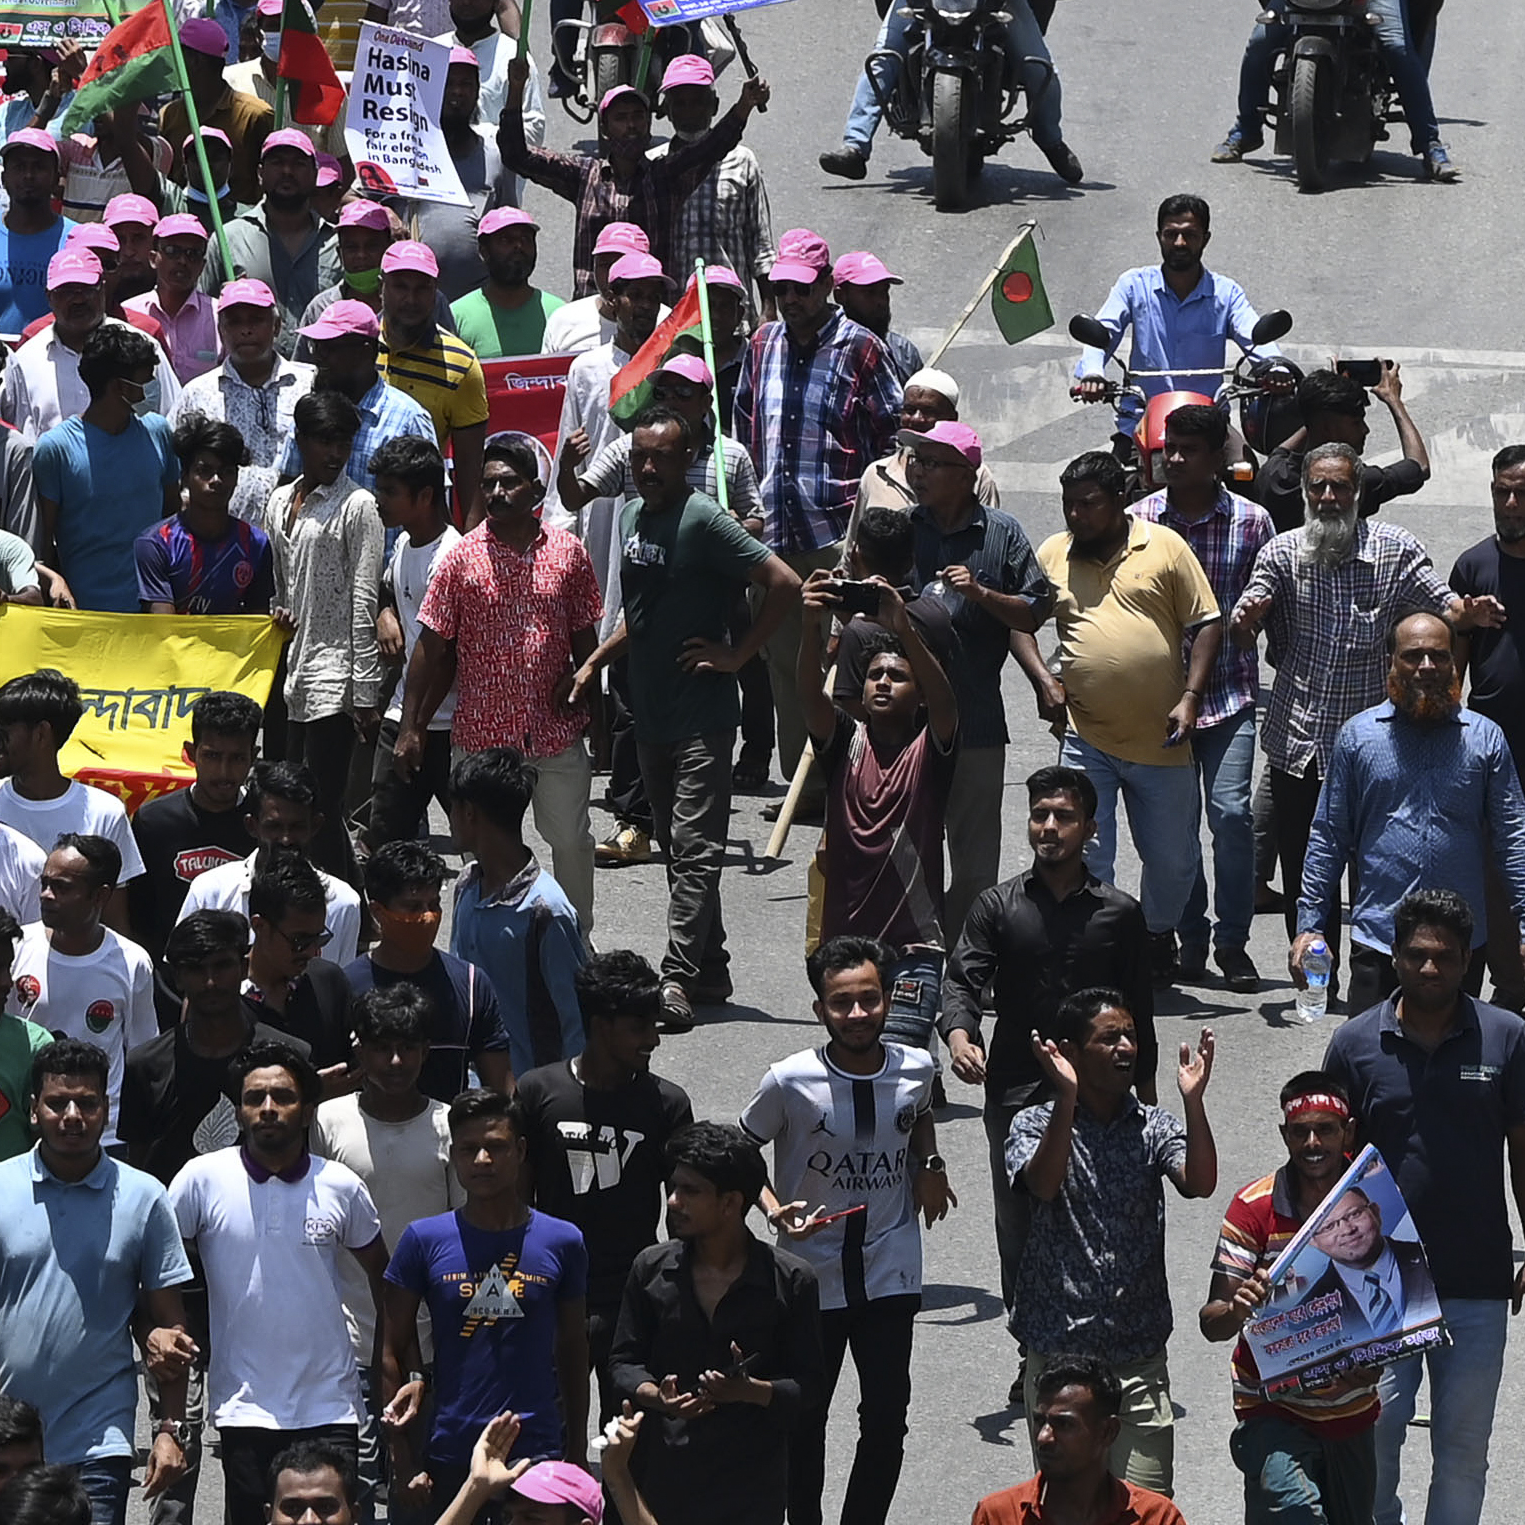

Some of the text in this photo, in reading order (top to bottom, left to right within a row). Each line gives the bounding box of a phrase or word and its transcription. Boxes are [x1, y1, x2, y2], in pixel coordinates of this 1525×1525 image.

[373, 30, 425, 53] One Demand
[367, 47, 431, 83] Hasina
[363, 73, 417, 103] Must
[362, 99, 429, 133] Resign
[364, 127, 387, 140] For
[389, 131, 397, 141] a
[365, 139, 429, 161] fair elecon
[367, 151, 381, 162] in
[79, 685, 213, 732] ন্দাবাদ
[807, 1147, 907, 1178] QATAR
[831, 1173, 904, 1191] AIRWAYS
